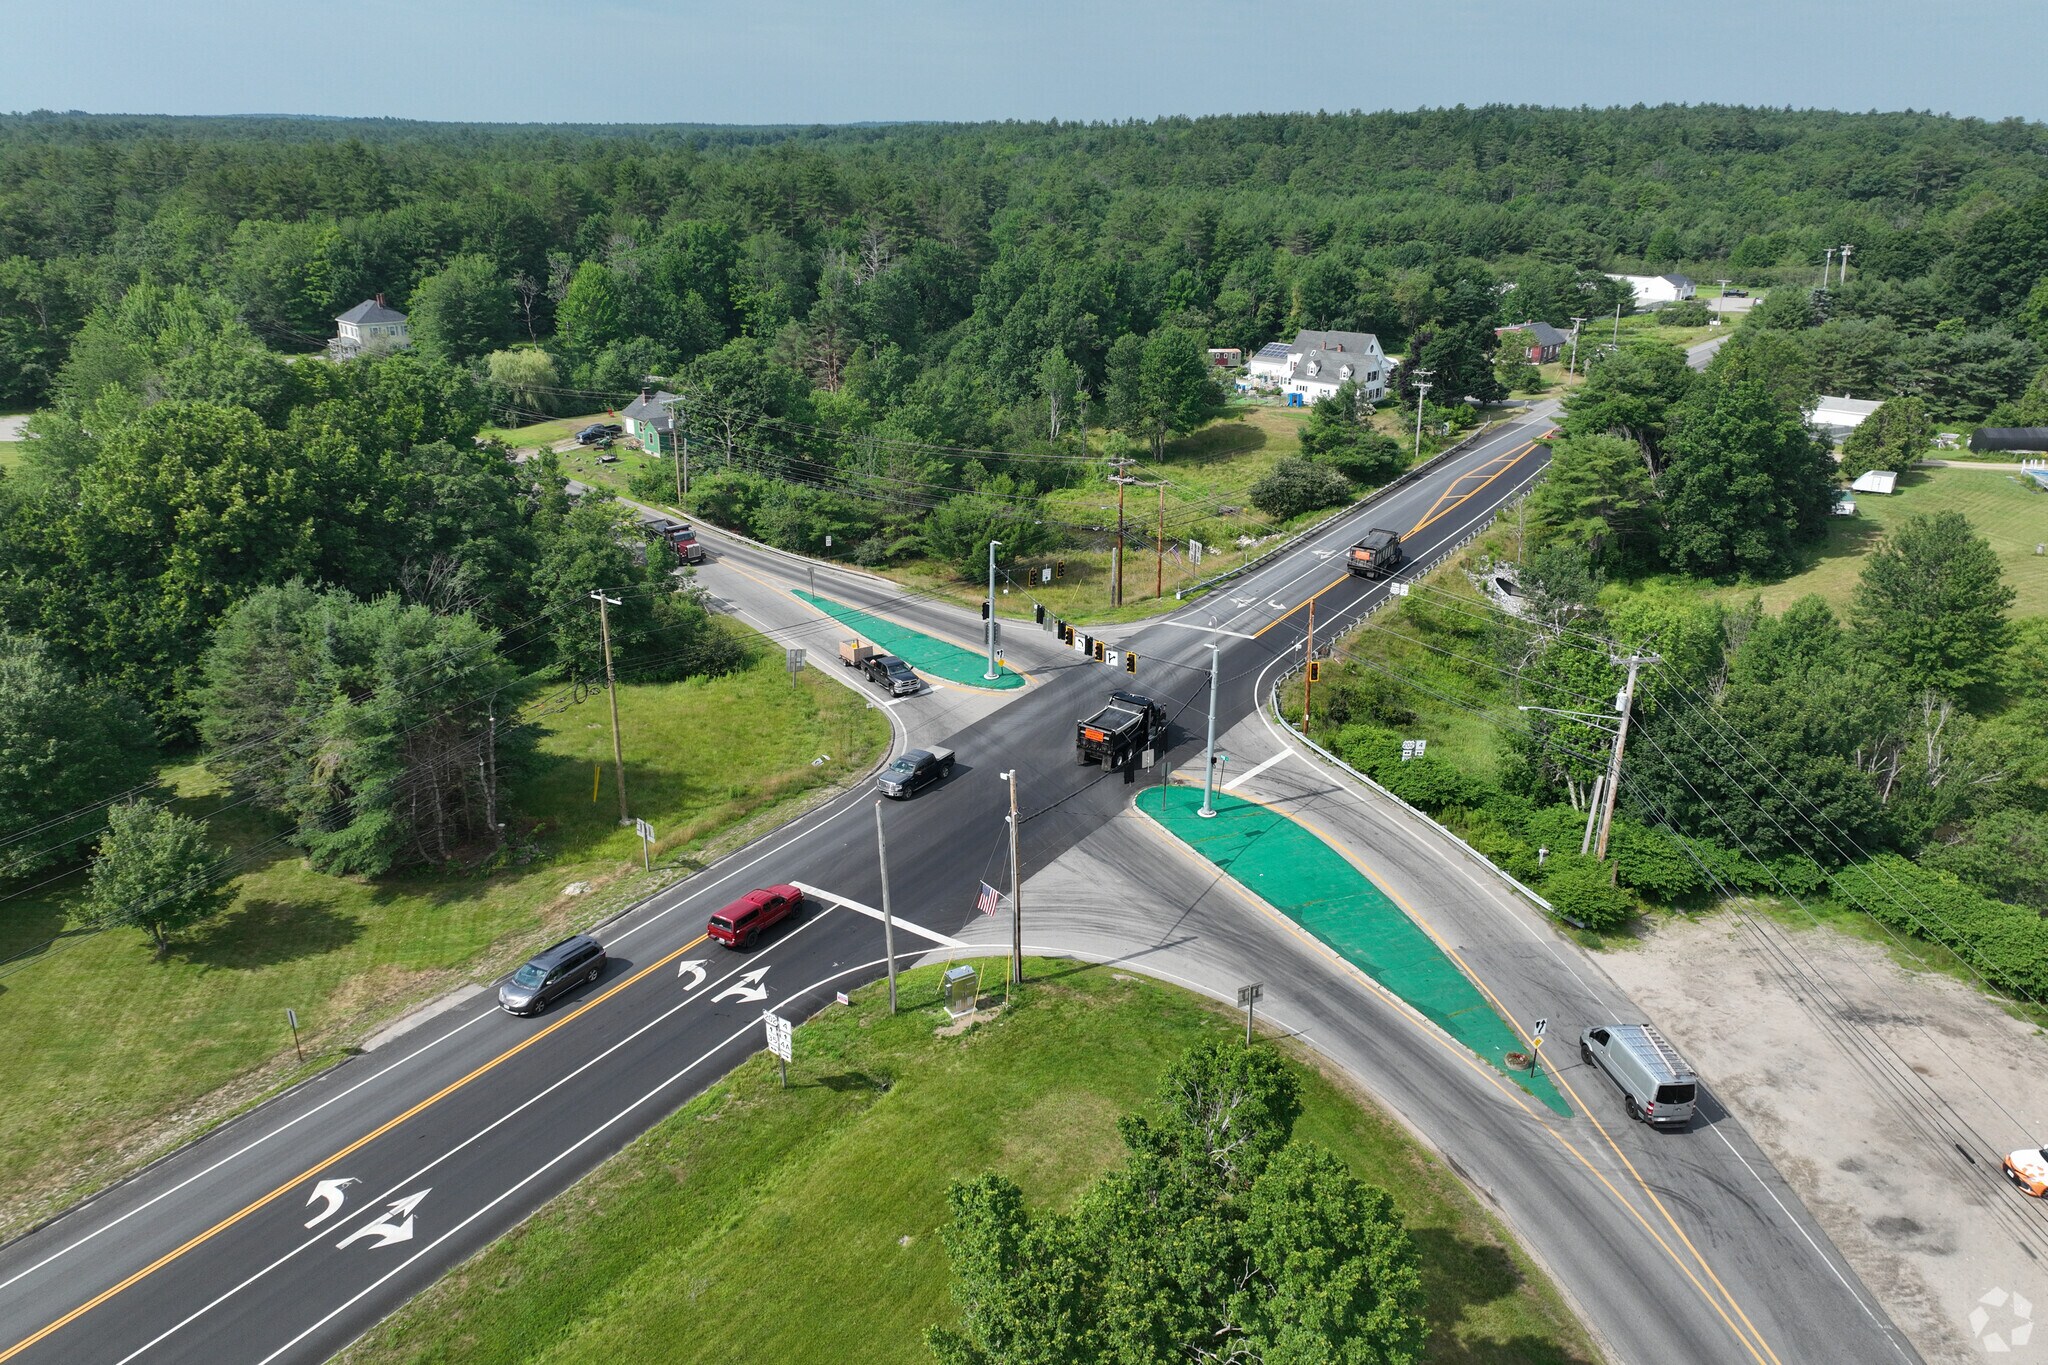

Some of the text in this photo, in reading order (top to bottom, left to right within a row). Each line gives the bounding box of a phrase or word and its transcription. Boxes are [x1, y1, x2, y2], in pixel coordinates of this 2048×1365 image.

[764, 1012, 777, 1025] 202
[768, 1033, 778, 1044] 35
[780, 1041, 790, 1050] 4A
